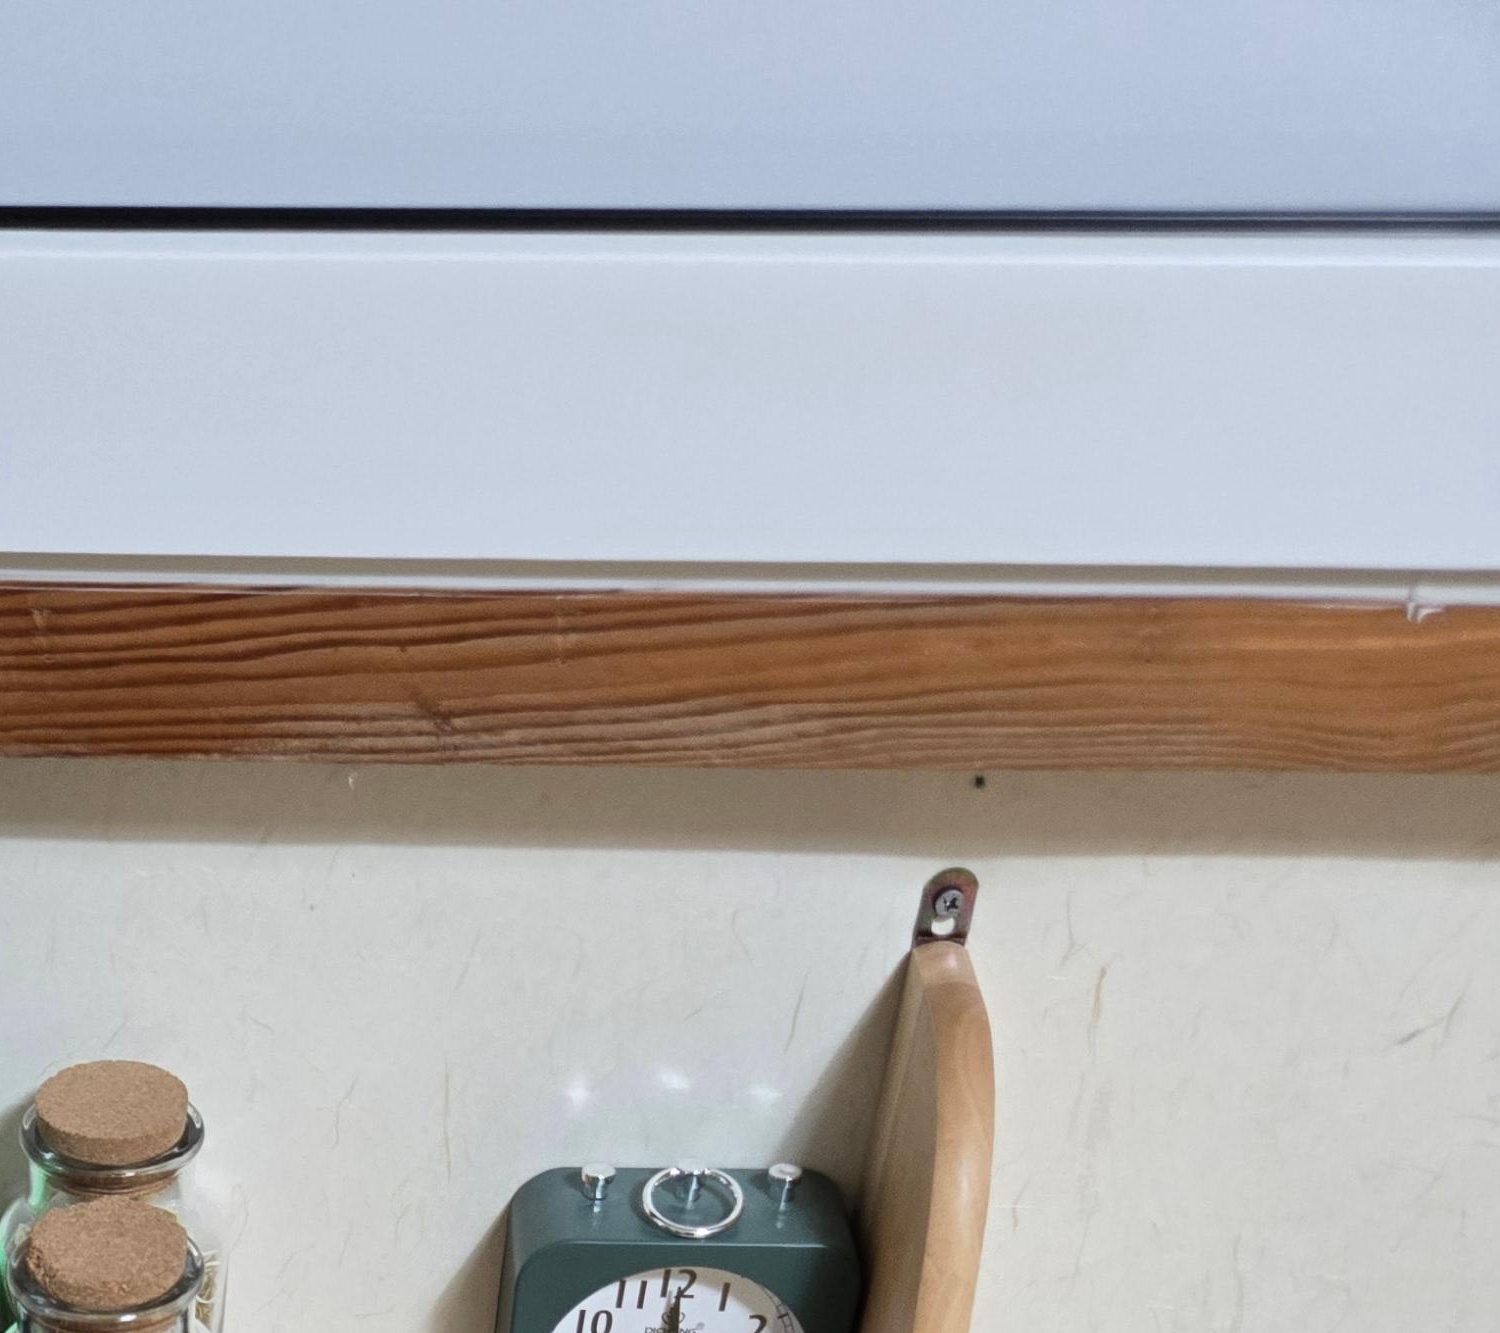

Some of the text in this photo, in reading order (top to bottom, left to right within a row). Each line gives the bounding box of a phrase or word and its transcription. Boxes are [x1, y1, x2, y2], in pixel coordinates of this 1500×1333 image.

[616, 1279, 648, 1309] 11
[660, 1268, 697, 1299] 12
[718, 1282, 731, 1312] 1
